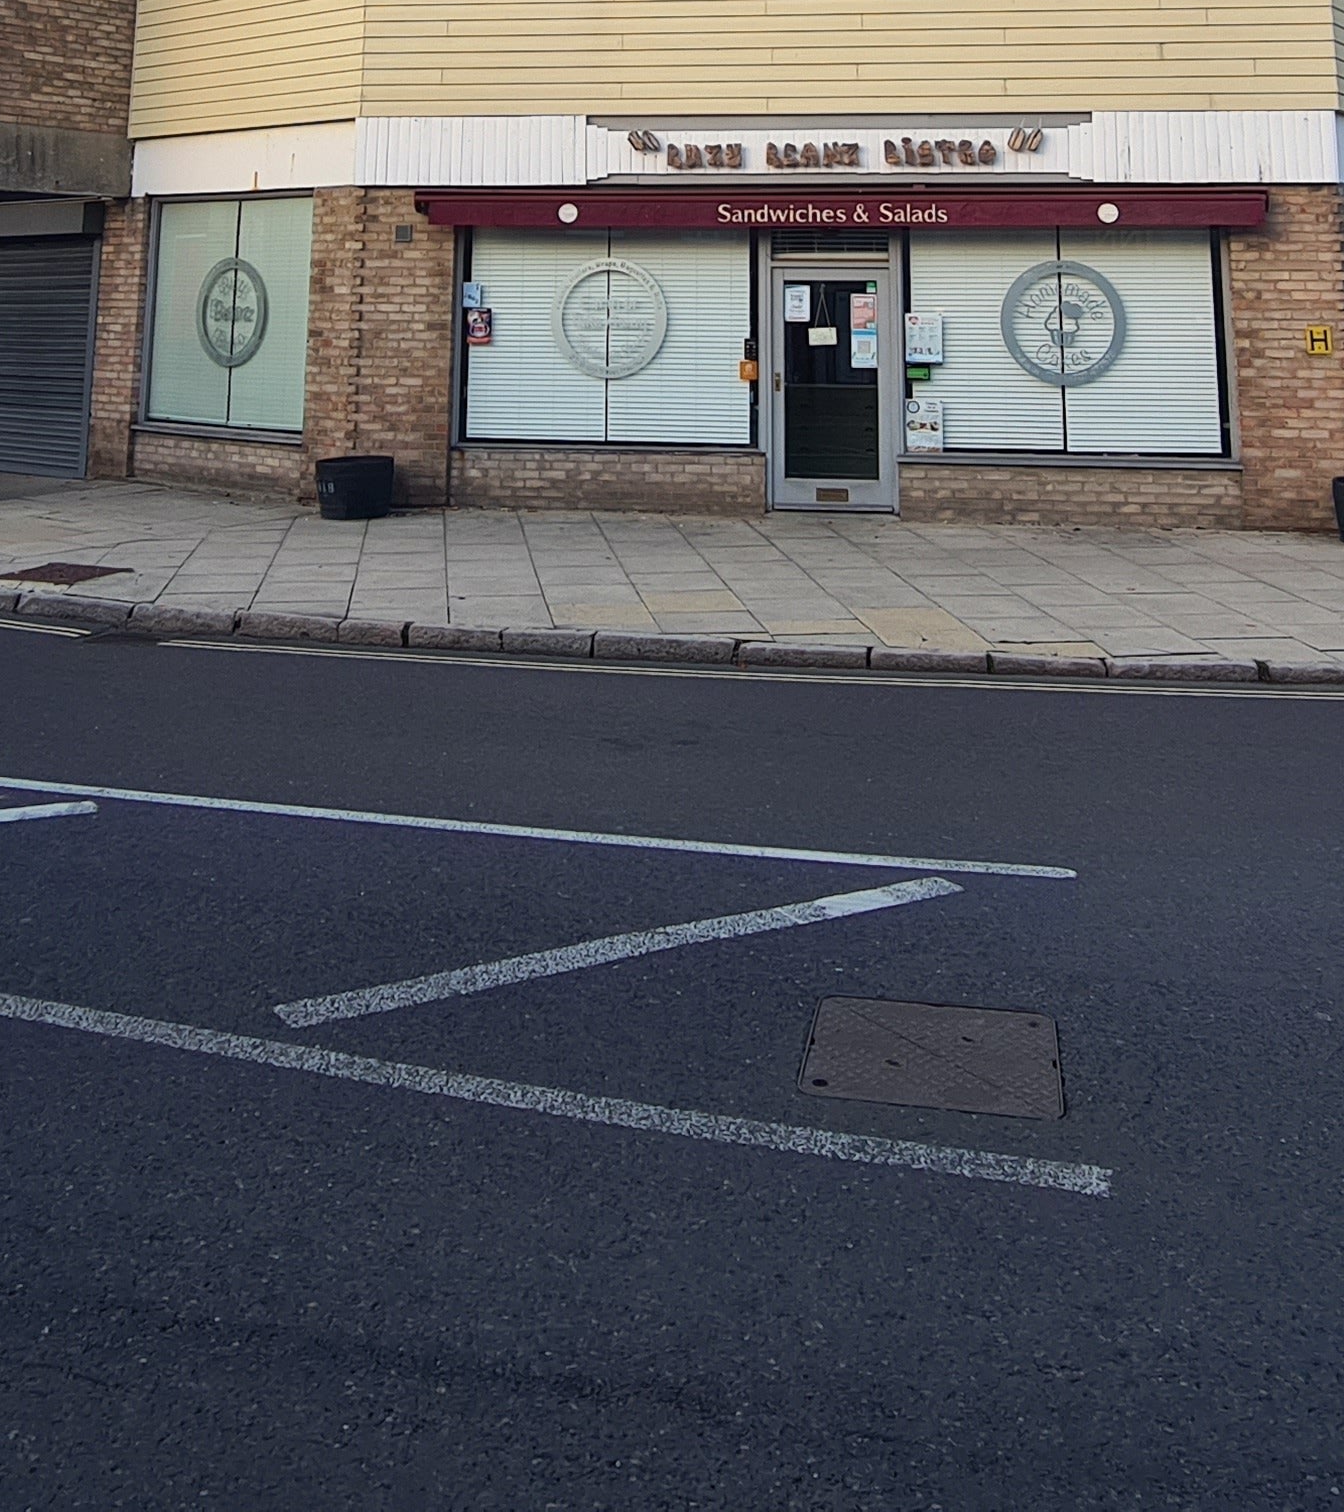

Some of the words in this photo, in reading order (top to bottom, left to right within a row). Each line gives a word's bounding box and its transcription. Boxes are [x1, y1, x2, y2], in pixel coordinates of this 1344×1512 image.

[717, 204, 847, 223] Sandwiches
[853, 203, 869, 223] &
[879, 203, 948, 223] Salads
[1309, 329, 1328, 351] H
